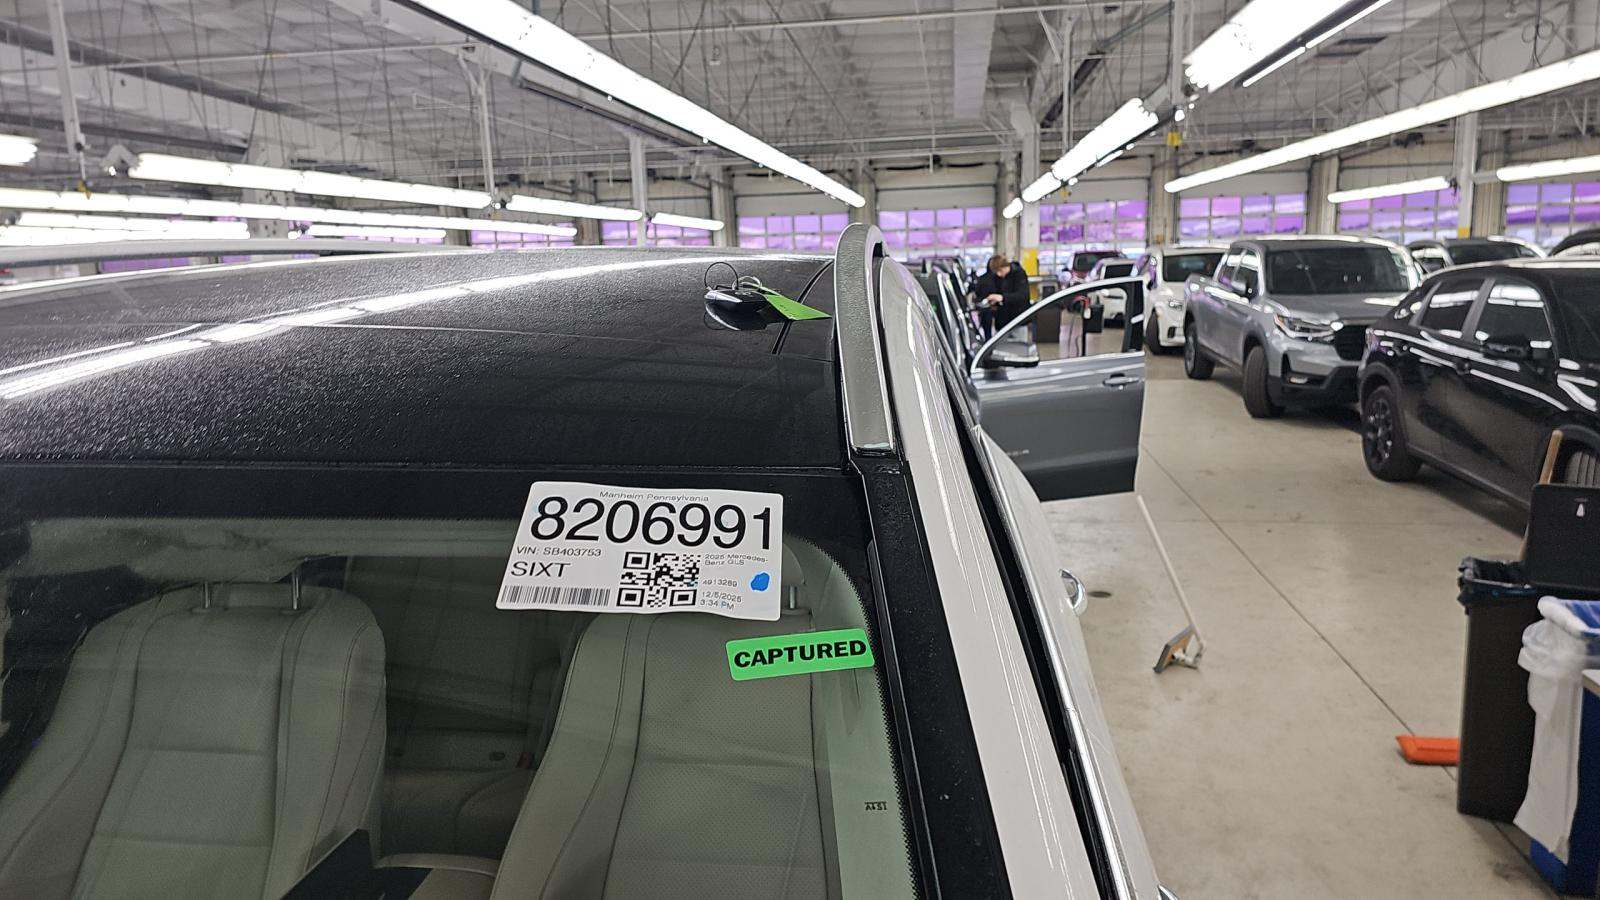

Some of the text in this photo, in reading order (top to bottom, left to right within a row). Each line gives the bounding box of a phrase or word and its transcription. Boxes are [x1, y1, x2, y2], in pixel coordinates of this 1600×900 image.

[599, 491, 709, 502] Manheim Pennsylvania
[531, 496, 770, 550] 8206991
[517, 546, 602, 556] VIN: SB403753
[511, 561, 571, 577] SIXT
[700, 599, 735, 610] 3:34 PM
[734, 640, 866, 668] CAPTURED
